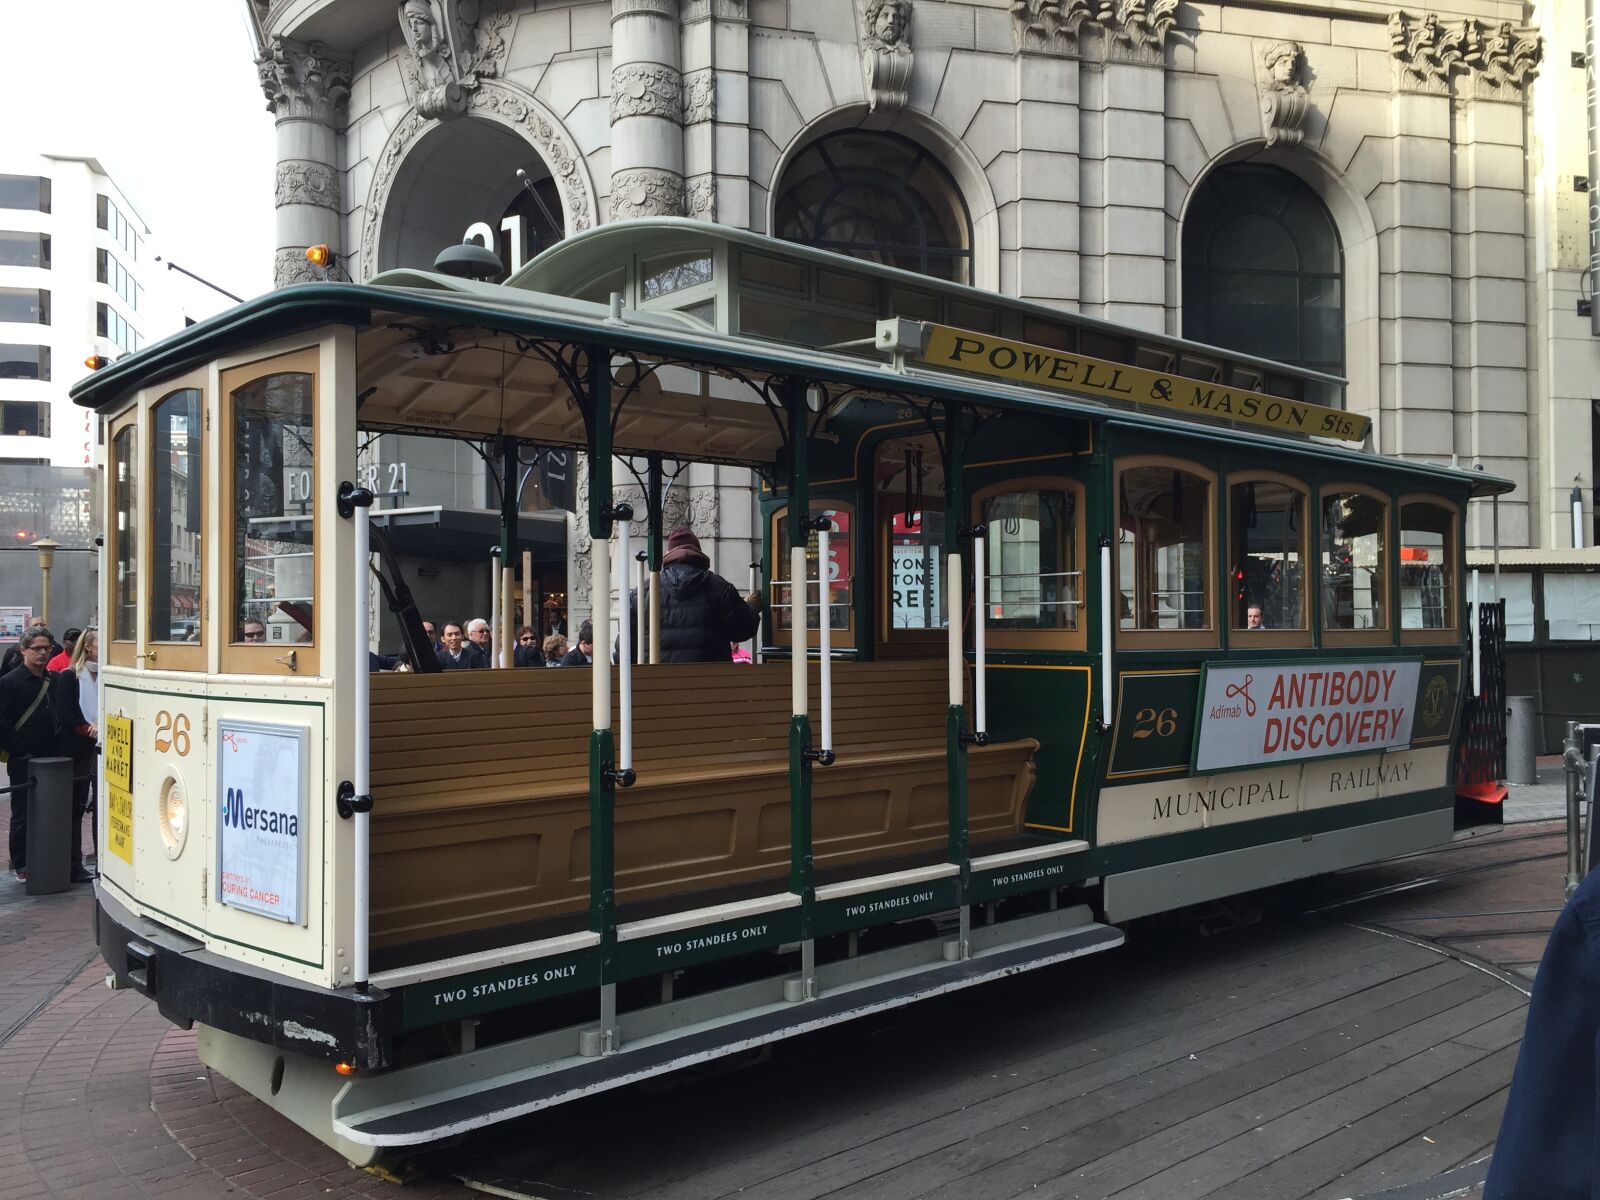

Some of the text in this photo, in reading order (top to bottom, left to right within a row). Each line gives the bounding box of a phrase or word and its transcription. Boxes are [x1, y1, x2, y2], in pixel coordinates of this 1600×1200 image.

[949, 336, 1355, 436] POWELL & MASON Sts.
[388, 462, 407, 494] 21
[547, 450, 567, 481] 21
[1267, 669, 1397, 711] ANTIBODY
[1132, 708, 1178, 738] 26
[1209, 703, 1242, 719] Adimab
[106, 723, 129, 746] POWELL
[155, 709, 191, 757] 26
[1263, 707, 1404, 754] DISCOVERY
[111, 744, 124, 759] AND
[105, 758, 129, 779] MARKET
[1152, 761, 1414, 820] MUNICIPAL RAILWAY
[225, 787, 298, 837] Mersana
[992, 865, 1064, 887] TWO STANDEES ONLY
[223, 881, 281, 907] CURING CANCER
[845, 891, 934, 917] TWO STANDEES ONLY
[656, 925, 768, 957] TWO STANDEES ONLY
[434, 965, 577, 1005] TWO STANDEES ONLY
